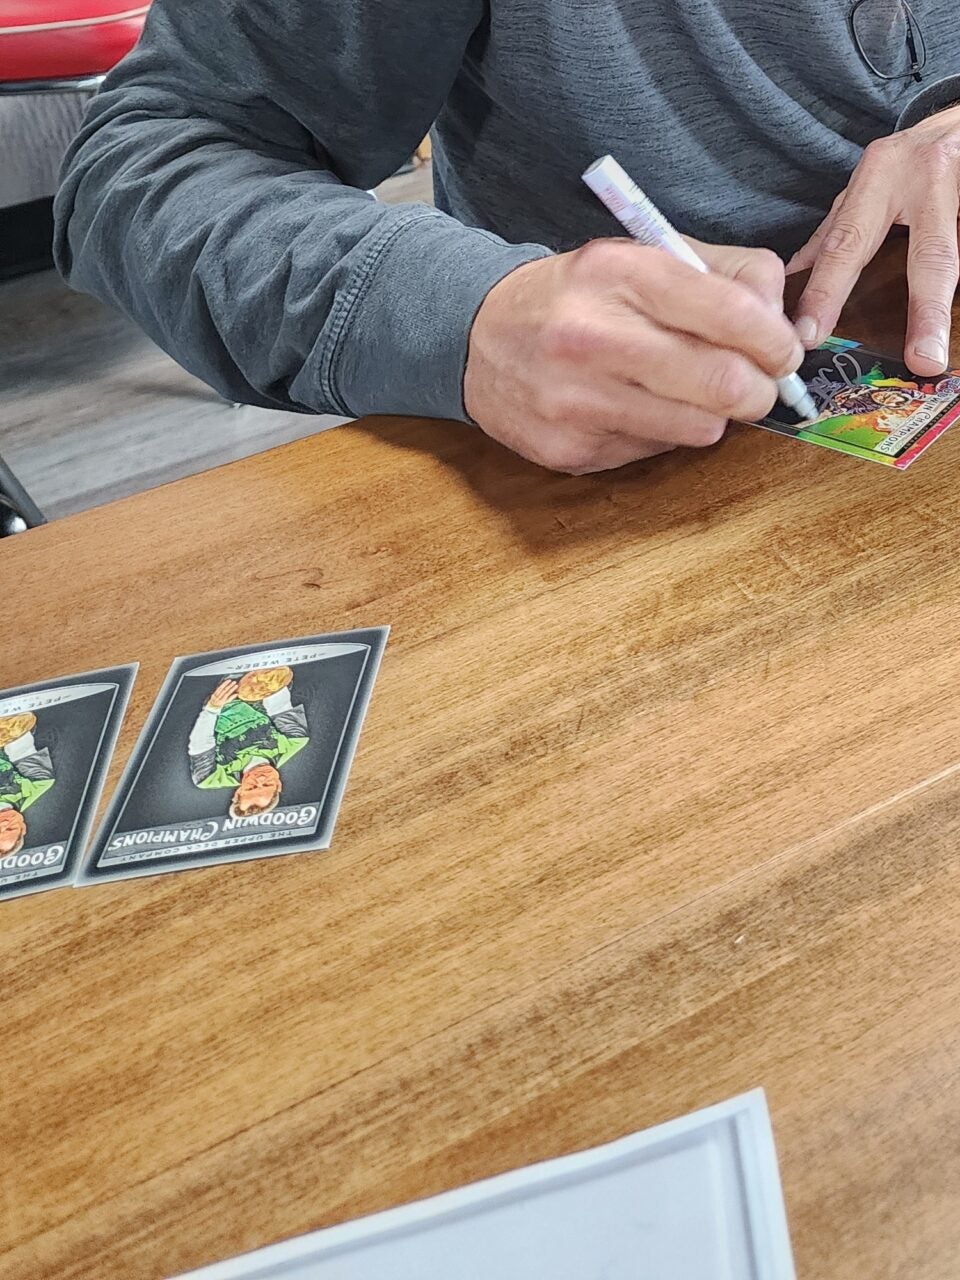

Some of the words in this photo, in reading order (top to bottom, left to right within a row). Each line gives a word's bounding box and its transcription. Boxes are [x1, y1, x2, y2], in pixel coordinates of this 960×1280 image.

[880, 411, 931, 452] CHAMPIONS
[235, 659, 280, 671] WEBER
[285, 652, 317, 664] PETE
[223, 804, 317, 832] GOODWIN
[111, 820, 219, 851] CHAMPIONS
[224, 834, 263, 846] UPPER
[268, 830, 293, 840] THE
[119, 847, 181, 863] COMPANY
